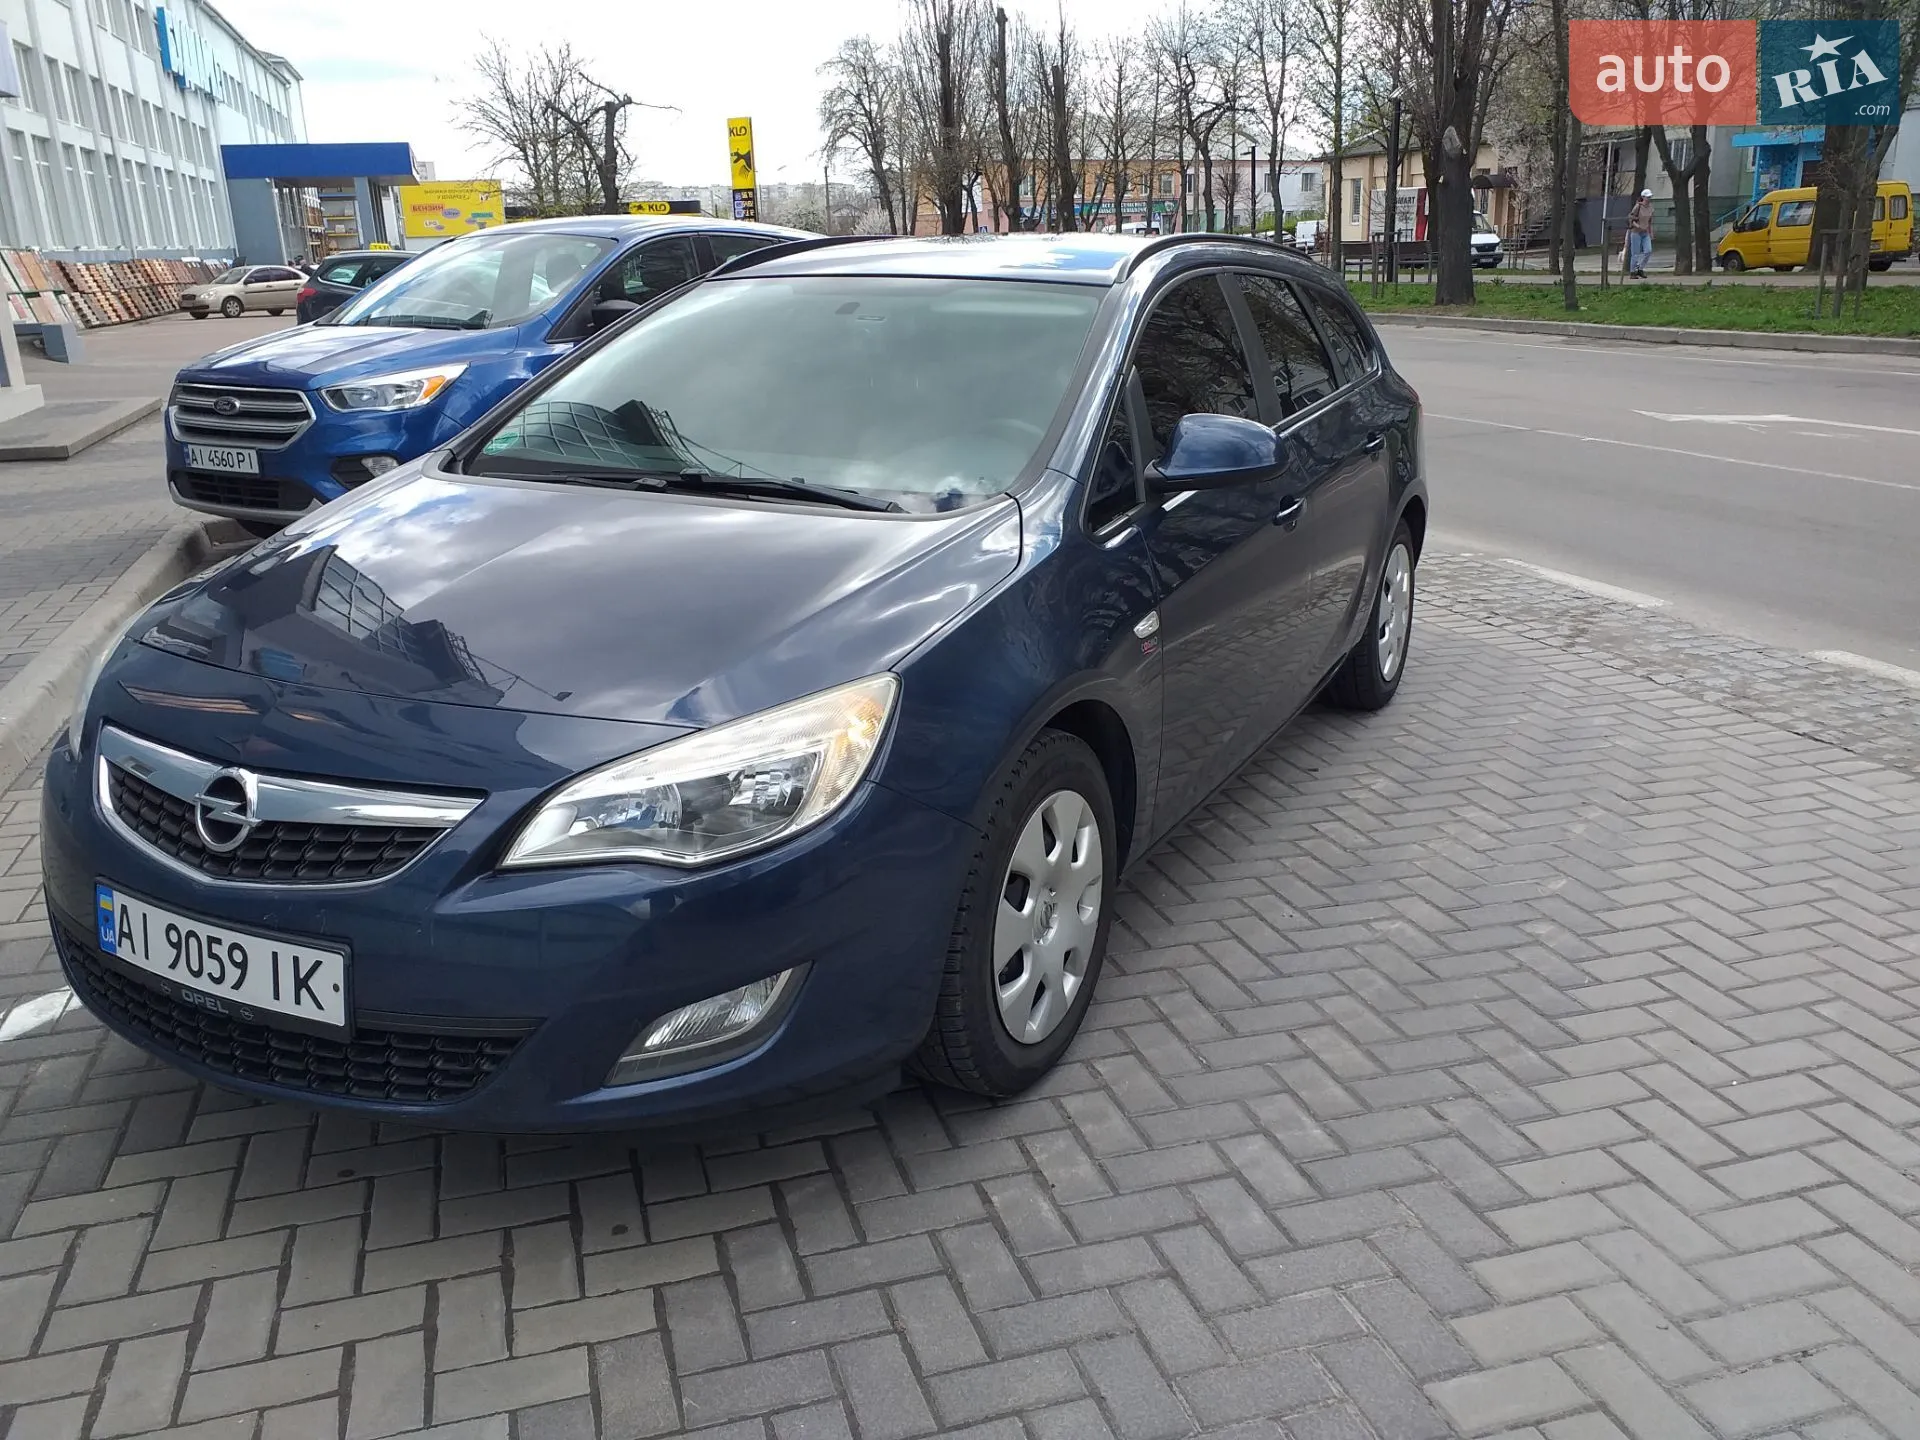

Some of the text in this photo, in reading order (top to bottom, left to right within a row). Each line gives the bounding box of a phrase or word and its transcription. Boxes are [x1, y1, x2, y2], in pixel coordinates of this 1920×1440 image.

[729, 126, 747, 137] KLO
[412, 203, 445, 213] БЕНЗИН
[647, 204, 667, 212] KLO
[190, 448, 204, 465] AI
[208, 450, 235, 468] 4560
[236, 452, 253, 469] PI
[101, 926, 115, 944] UA
[117, 903, 324, 1011] AI 9059 IK
[182, 989, 229, 1014] OPEL
